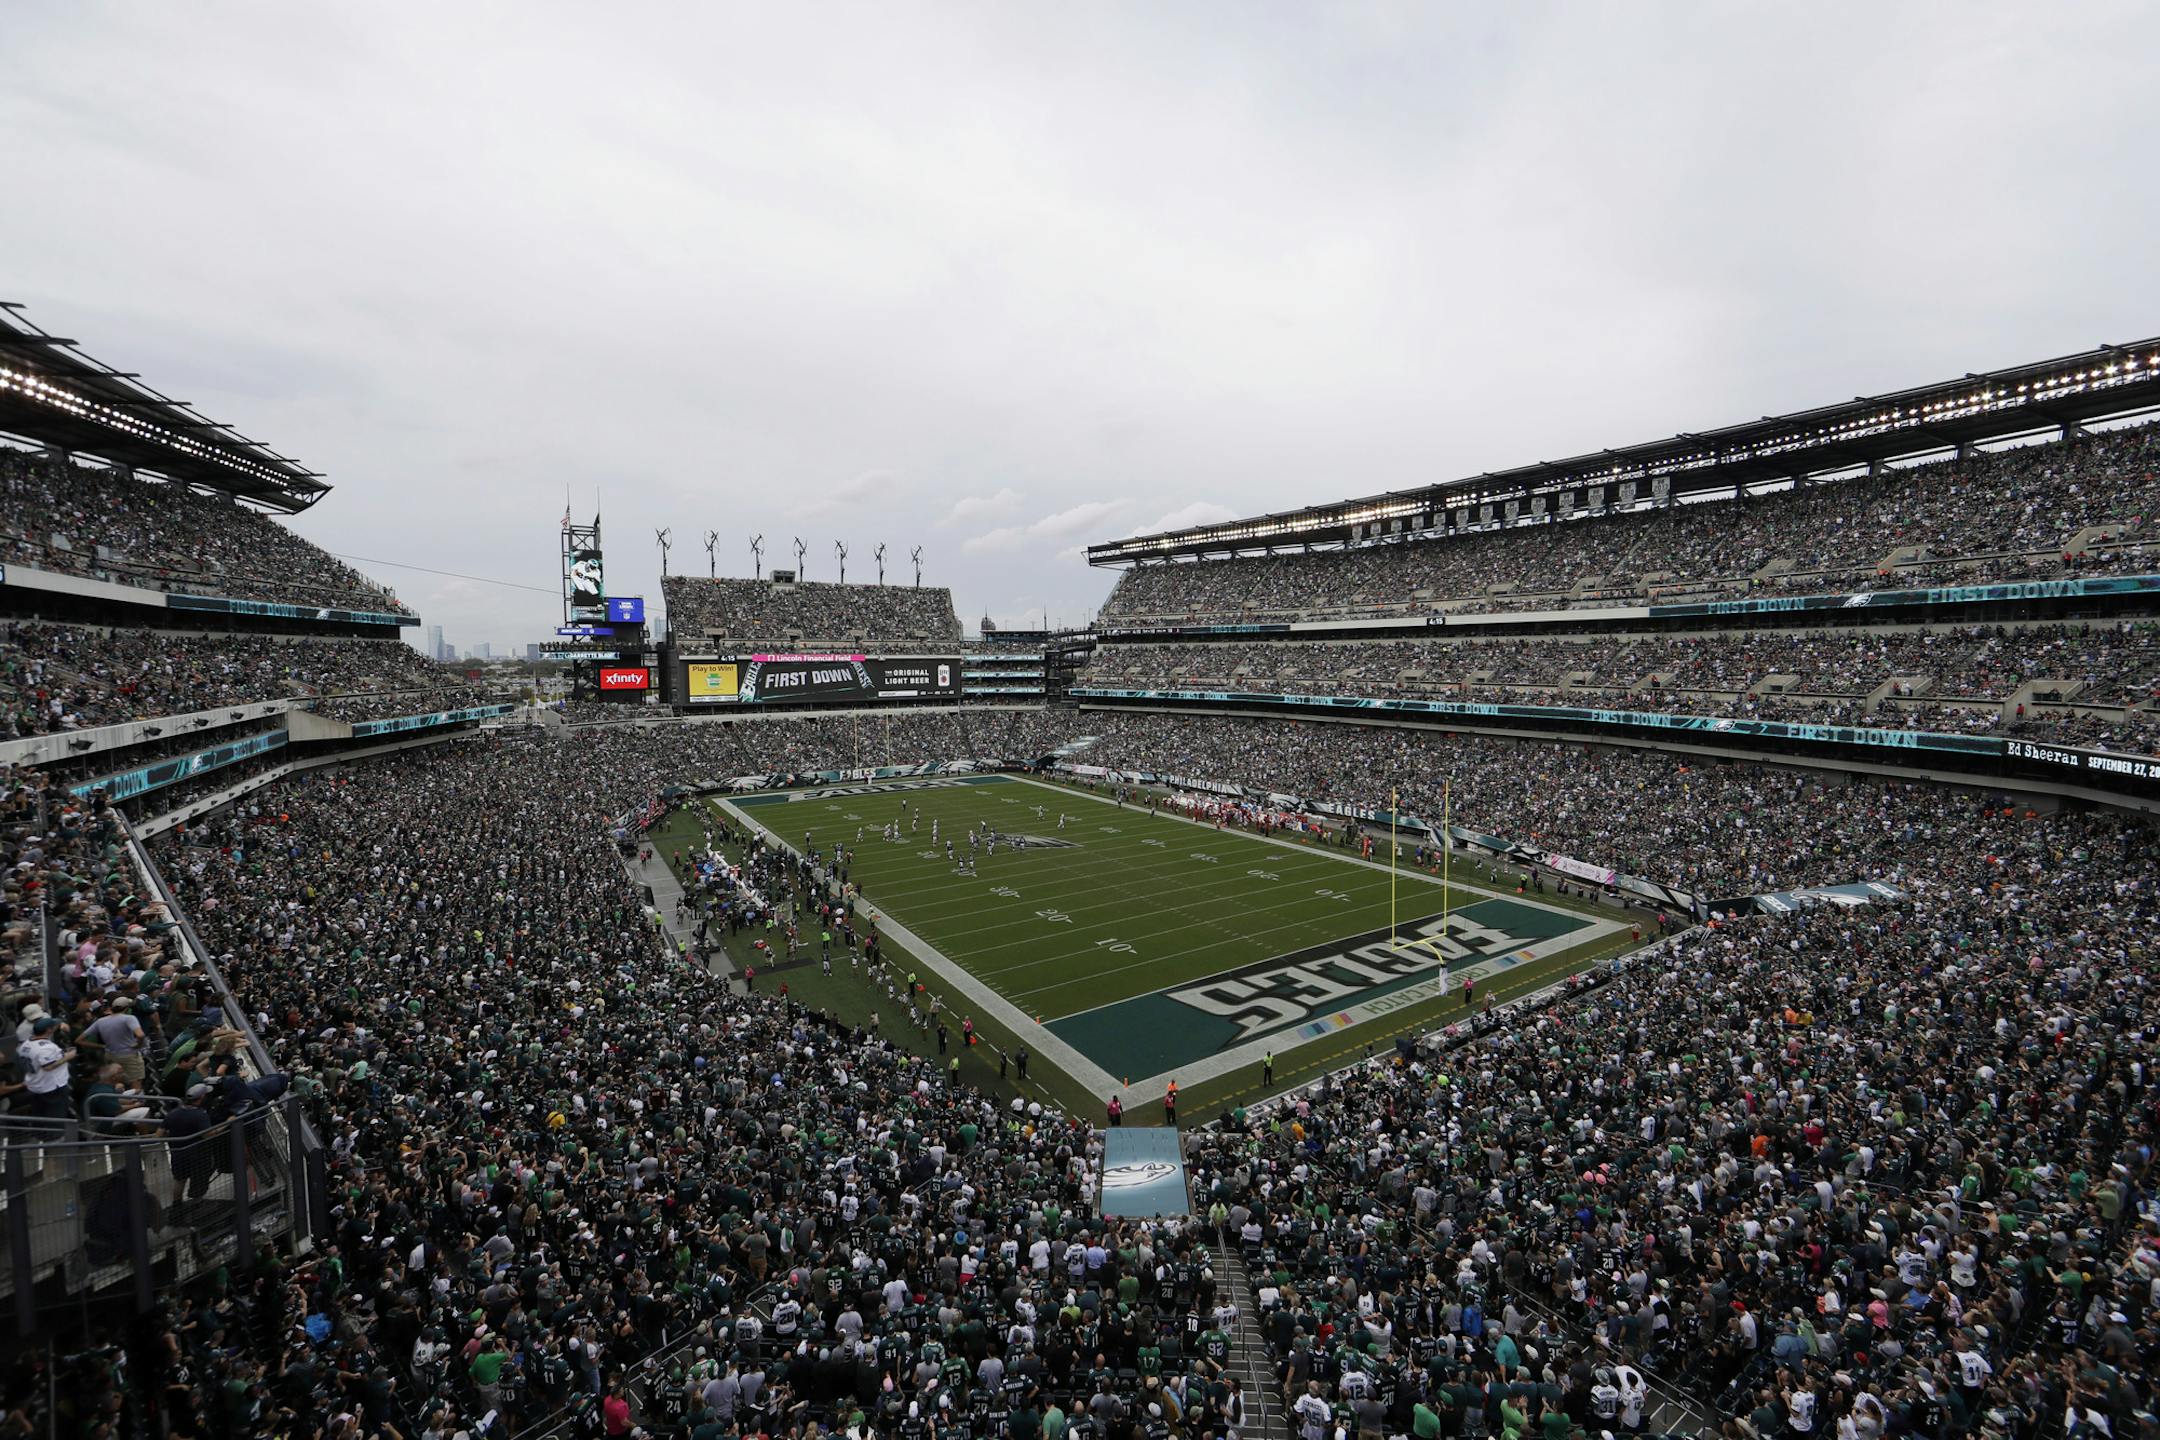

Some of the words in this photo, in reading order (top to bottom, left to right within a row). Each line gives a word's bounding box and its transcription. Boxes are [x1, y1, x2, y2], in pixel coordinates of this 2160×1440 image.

[1928, 588, 1989, 603] FIRST
[2006, 580, 2084, 599] DOWN
[229, 600, 260, 614] FIRST
[268, 602, 296, 617] DOWN
[1707, 601, 1748, 614] FIRST
[1757, 598, 1805, 612] DOWN
[1210, 625, 1233, 633] FIRST
[1237, 624, 1260, 632] DOWN
[1429, 617, 1443, 626] 4:15
[692, 665, 707, 673] Play
[606, 673, 643, 685] xfinity
[765, 671, 807, 689] FIRST
[812, 668, 853, 684] DOWN
[885, 677, 908, 685] LIGHT
[1179, 692, 1199, 700] FIRST
[1204, 692, 1228, 700] DOWN
[1284, 695, 1306, 704] FIRST
[1309, 696, 1333, 705] DOWN
[1429, 703, 1458, 713] FIRST
[1464, 704, 1499, 715] DOWN
[370, 720, 394, 734] FIRST
[400, 717, 421, 730] DOWN
[1591, 711, 1627, 723] FIRST
[1632, 713, 1672, 727] DOWN
[1788, 724, 1841, 742] FIRST
[1854, 729, 1917, 748] DOWN
[2007, 742, 2021, 757] Ed
[2024, 744, 2079, 766] Sheeran
[2088, 756, 2132, 776] SEPTEMBER
[2134, 763, 2147, 778] 27,
[115, 769, 149, 800] DOWN
[1169, 775, 1227, 794] PHILADELPHIA
[1327, 802, 1376, 820] EAGLES
[1035, 908, 1073, 923] 20
[1095, 937, 1136, 954] 10
[1166, 913, 1539, 1040] EAGLES
[1361, 989, 1424, 1015] CATCH
[1072, 1254, 1084, 1265] 54
[827, 1278, 843, 1290] 92
[779, 1312, 794, 1324] 20
[1405, 1307, 1417, 1319] 20
[885, 1349, 897, 1359] 91
[1207, 1342, 1224, 1357] 92
[1143, 1356, 1155, 1369] 17
[1313, 1363, 1324, 1373] 11
[1340, 1359, 1348, 1373] 9
[543, 1371, 555, 1385] 11
[1968, 1365, 1981, 1381] 11
[1350, 1386, 1365, 1400] 12
[1382, 1391, 1395, 1406] 20
[666, 1400, 681, 1414] 24
[1600, 1400, 1614, 1413] 31
